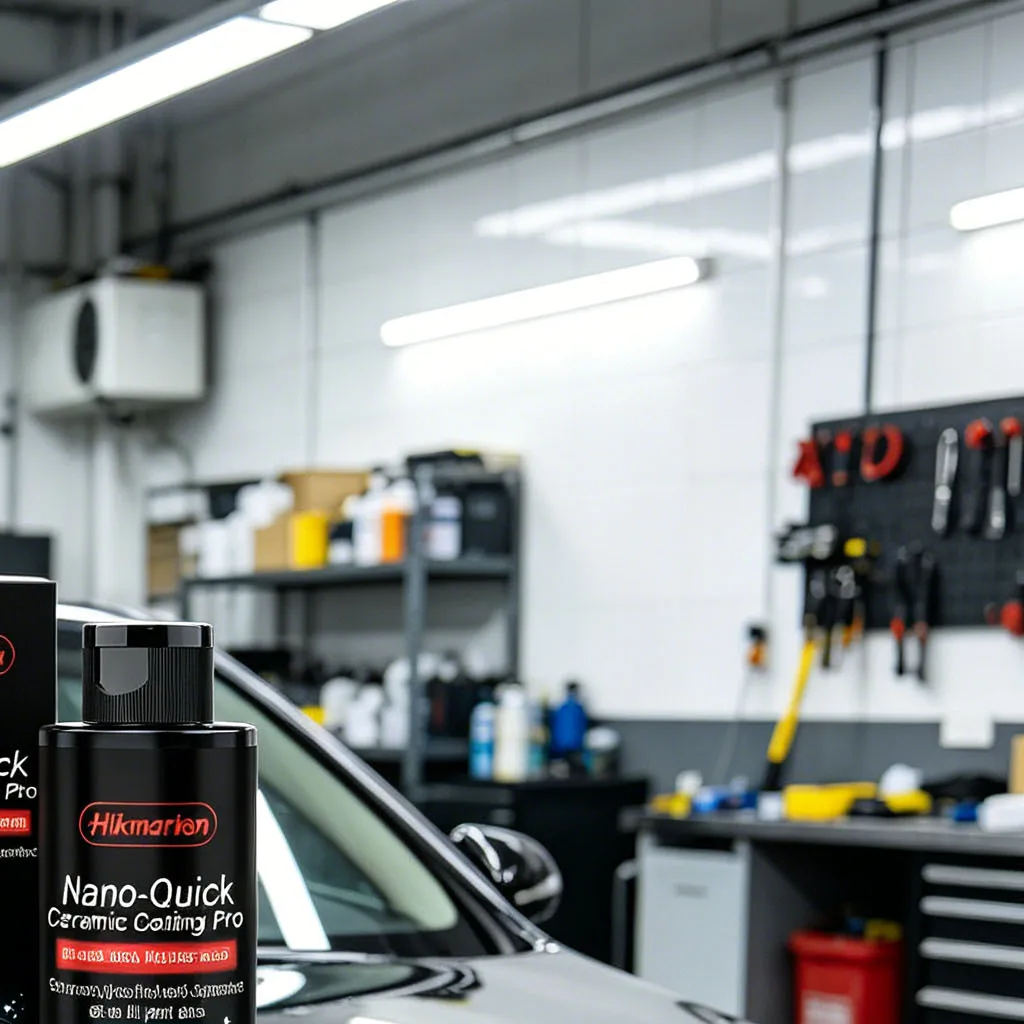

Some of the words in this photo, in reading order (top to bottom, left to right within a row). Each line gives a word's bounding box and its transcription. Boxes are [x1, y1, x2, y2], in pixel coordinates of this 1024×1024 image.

[5, 782, 38, 801] Pro
[62, 873, 235, 909] Nano-Quick
[47, 906, 128, 932] Ceramic
[212, 909, 244, 931] Pro
